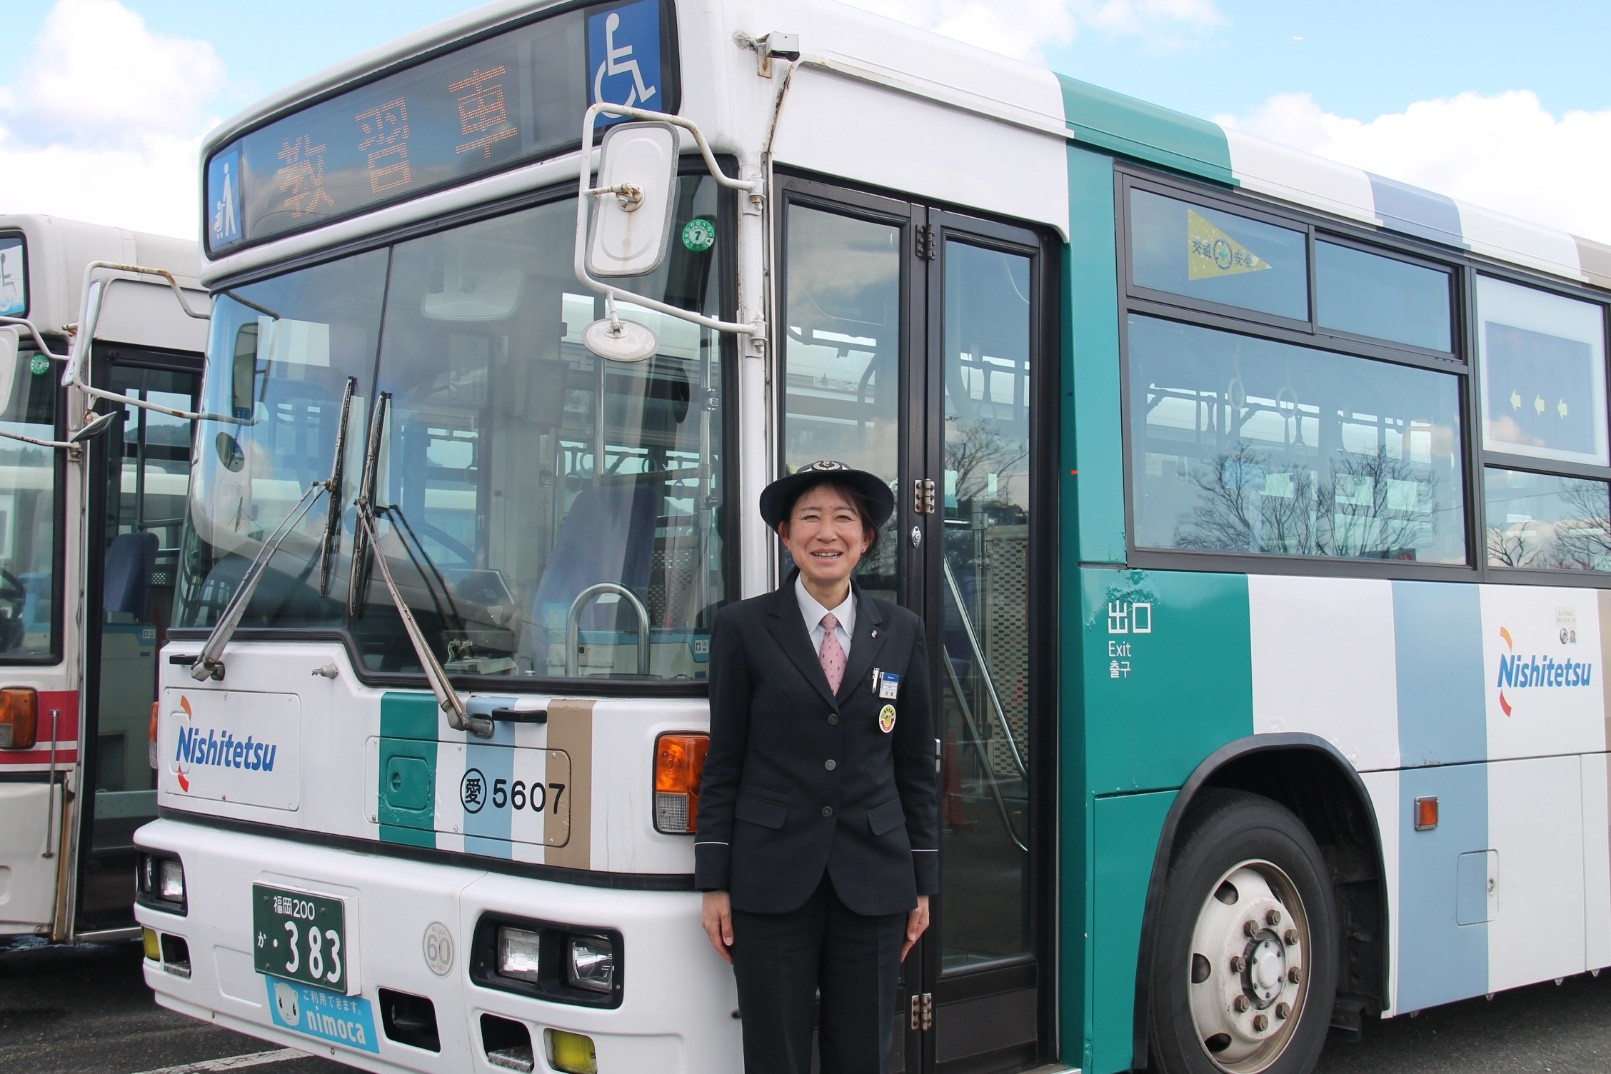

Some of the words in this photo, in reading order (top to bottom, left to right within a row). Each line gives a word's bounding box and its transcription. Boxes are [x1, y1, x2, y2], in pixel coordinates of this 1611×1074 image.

[277, 65, 518, 219] 教習車
[1108, 599, 1152, 634] 出口
[1108, 640, 1131, 657] Exit
[1109, 660, 1131, 679] 출구
[1497, 653, 1592, 689] Nishitetsu
[176, 726, 277, 772] Nishitetsu
[463, 773, 484, 809] 愛
[492, 781, 565, 815] 5607
[257, 931, 267, 948] か
[427, 933, 451, 965] 60
[303, 989, 362, 1016] ご利用できます。
[307, 1005, 366, 1046] nimoca
